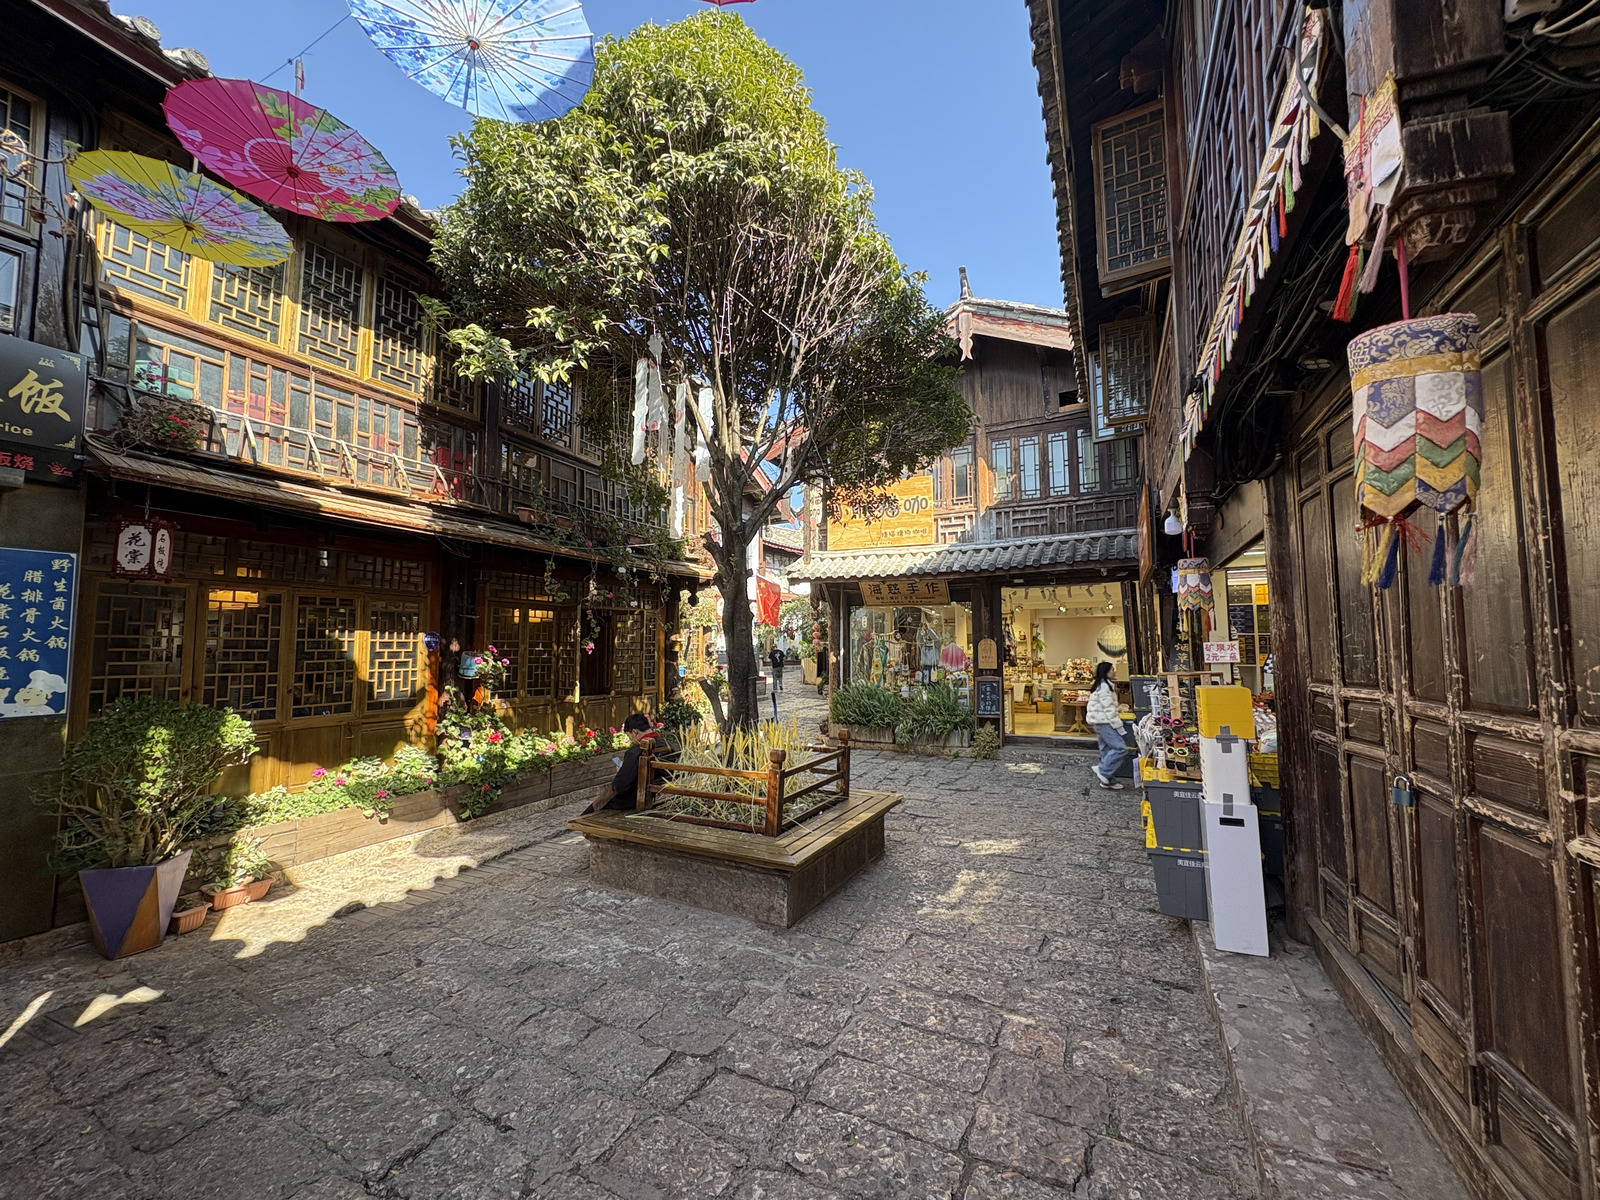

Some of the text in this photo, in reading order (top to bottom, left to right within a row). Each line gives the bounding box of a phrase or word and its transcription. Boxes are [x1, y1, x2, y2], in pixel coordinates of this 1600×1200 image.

[0, 368, 72, 422] 饭
[1205, 643, 1237, 652] 矿泉水
